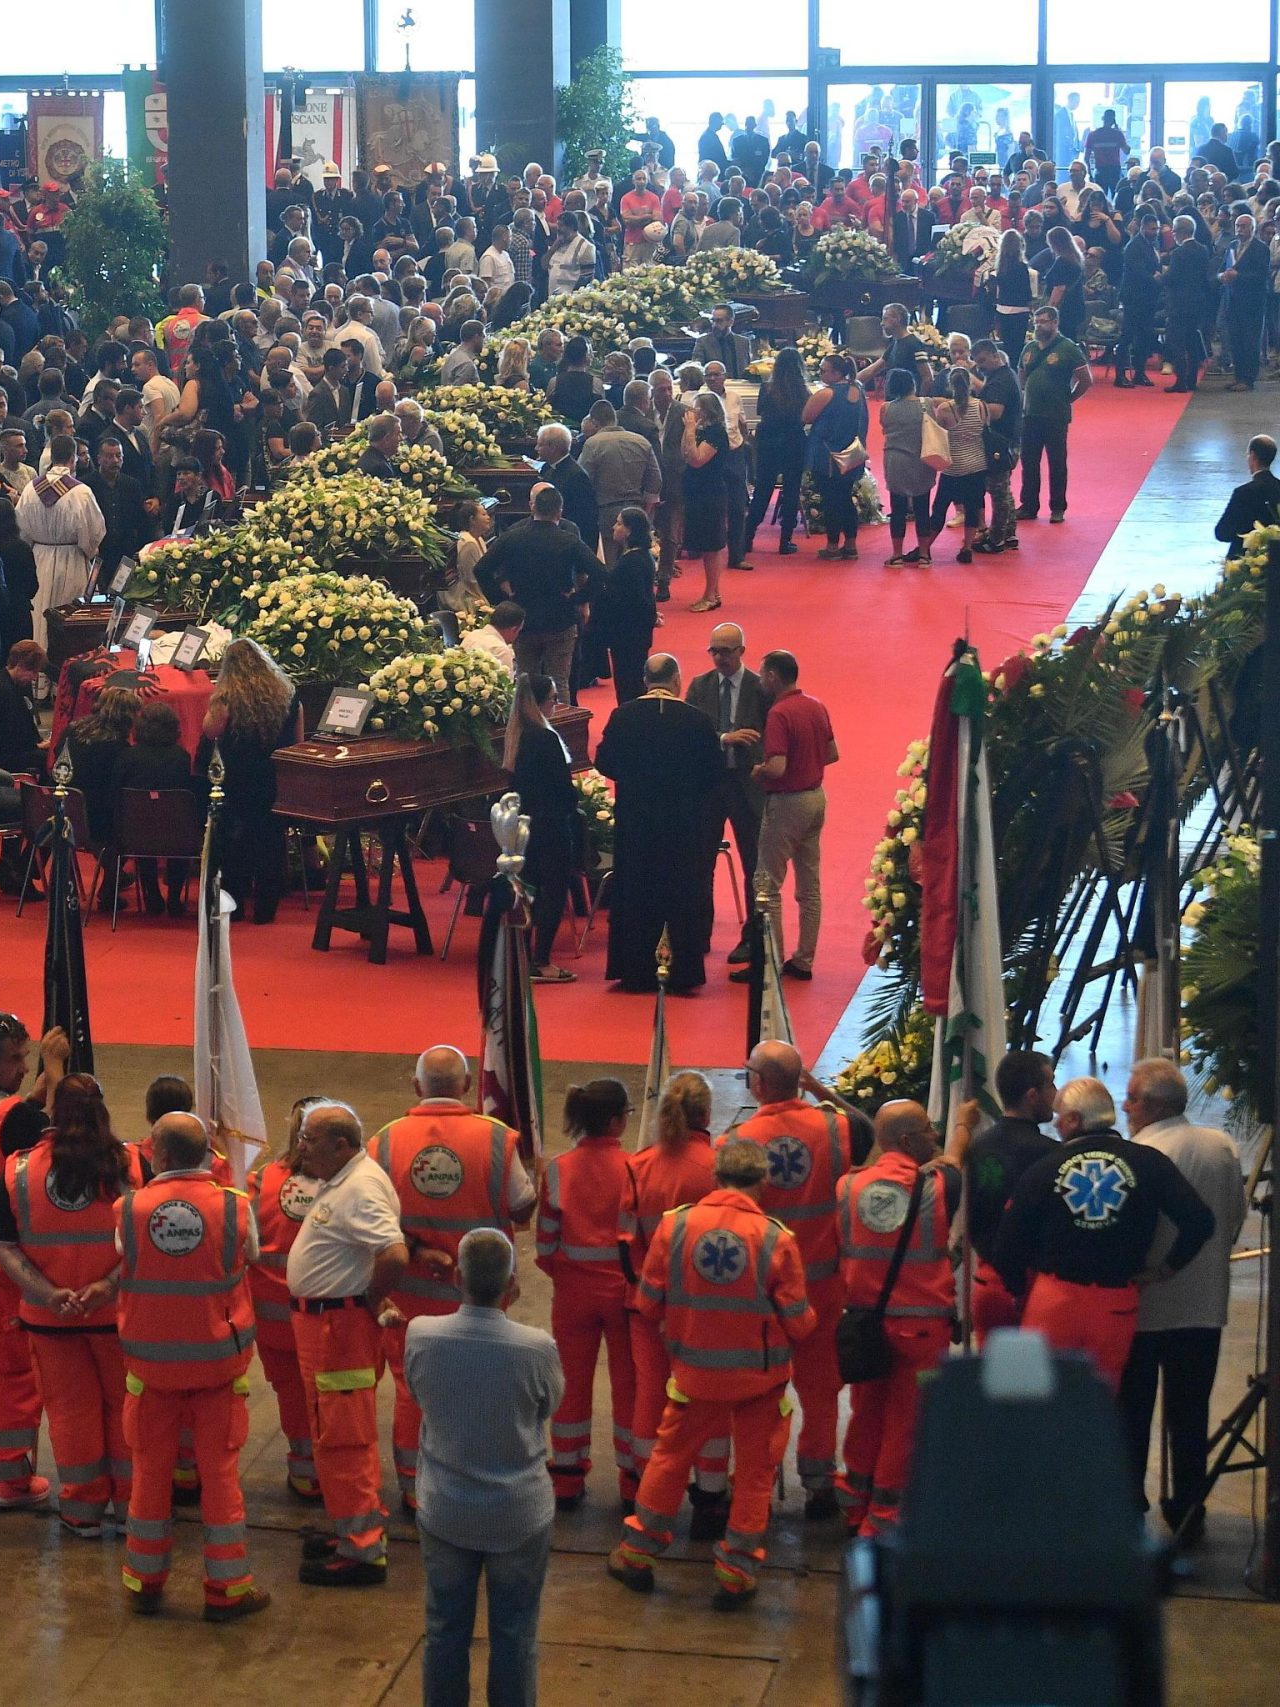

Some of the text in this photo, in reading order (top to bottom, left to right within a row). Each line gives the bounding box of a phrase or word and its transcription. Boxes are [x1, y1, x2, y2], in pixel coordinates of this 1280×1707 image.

[293, 113, 327, 124] SCANA
[427, 1173, 460, 1181] ANPAS
[294, 1195, 314, 1204] ANP
[167, 1228, 201, 1237] ANPAS
